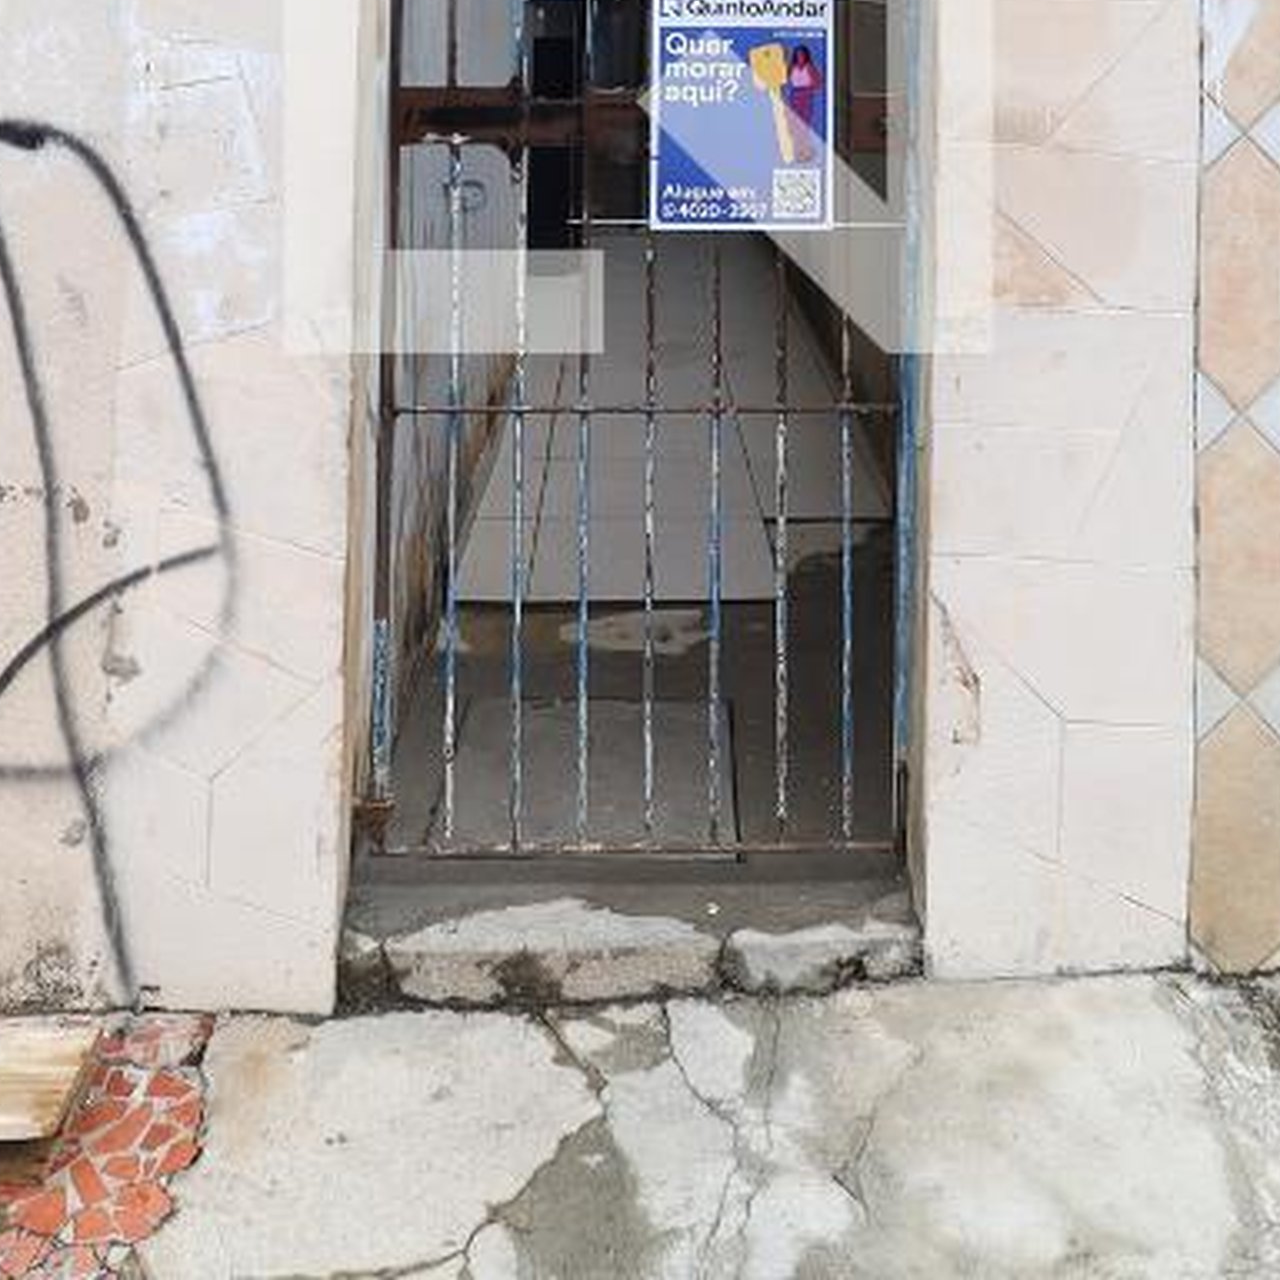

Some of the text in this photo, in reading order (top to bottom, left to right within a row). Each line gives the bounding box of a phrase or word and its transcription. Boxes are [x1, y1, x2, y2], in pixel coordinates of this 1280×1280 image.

[665, 31, 734, 58] Quer
[665, 61, 747, 79] morar
[665, 79, 739, 107] aqui?
